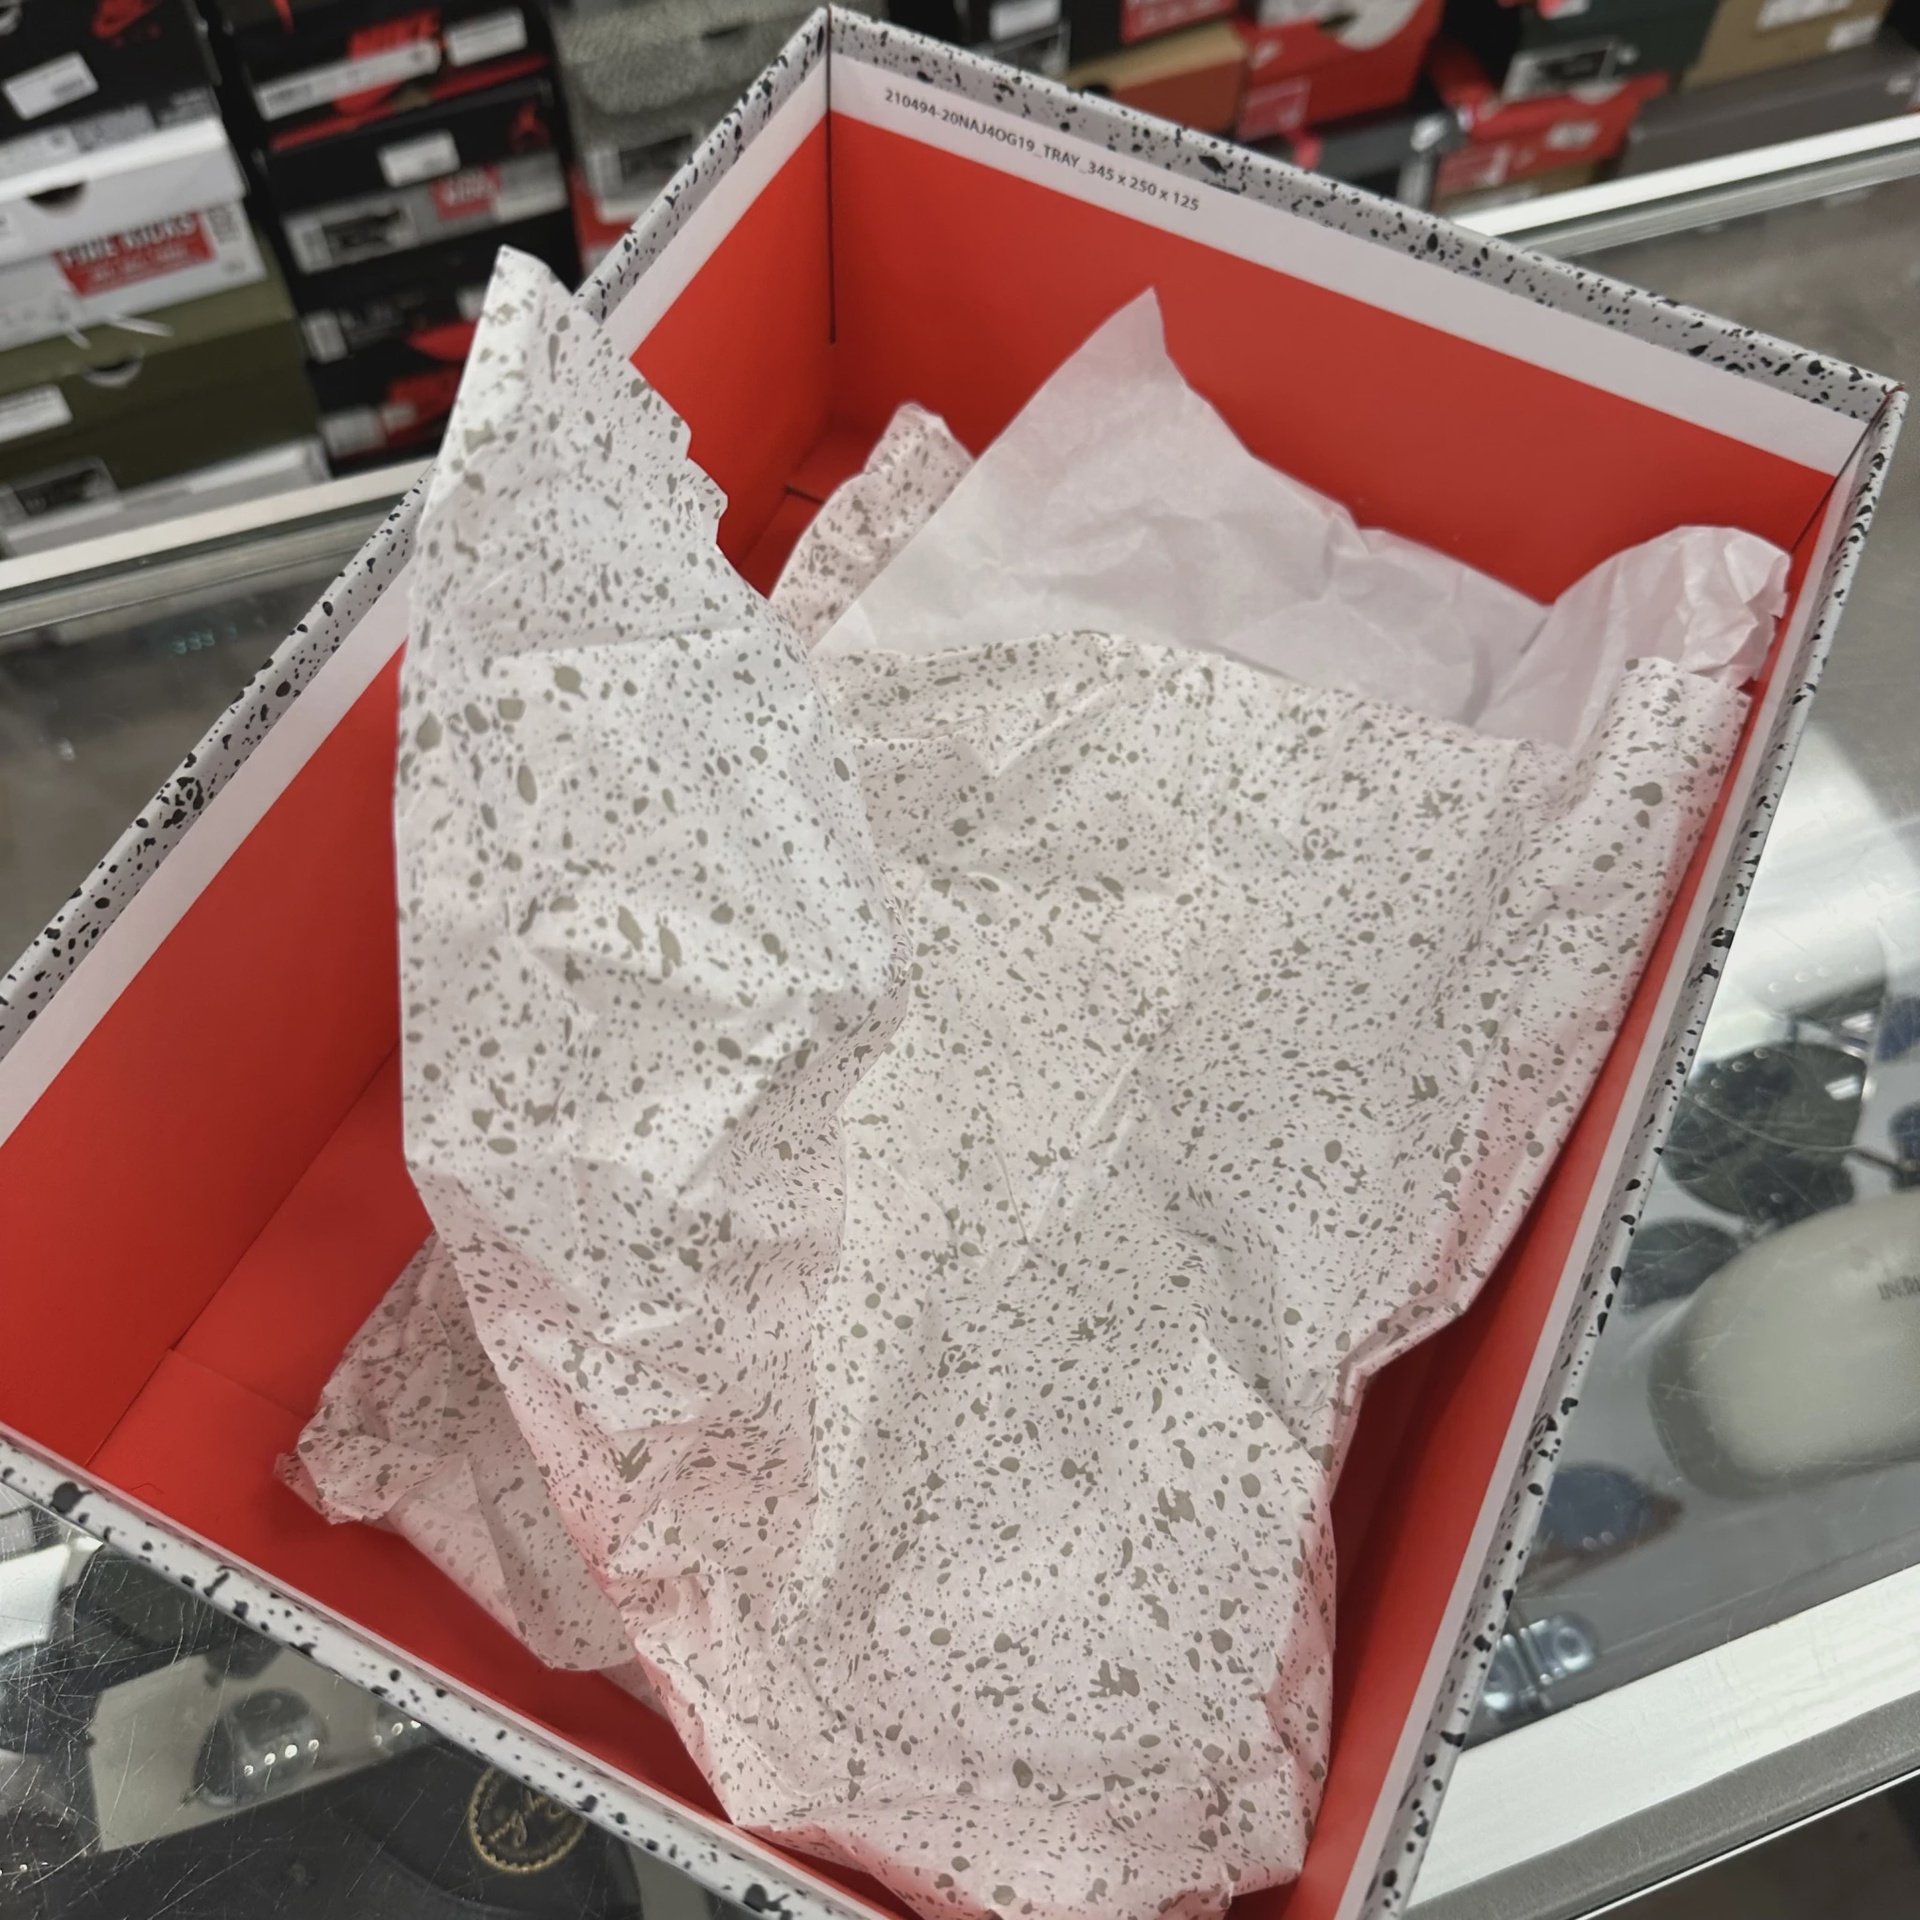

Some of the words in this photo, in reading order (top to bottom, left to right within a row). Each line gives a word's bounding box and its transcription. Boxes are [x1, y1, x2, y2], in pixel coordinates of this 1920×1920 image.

[1117, 173, 1127, 184] x
[1129, 176, 1157, 197] 250
[1159, 189, 1168, 200] x
[1174, 192, 1200, 212] 125
